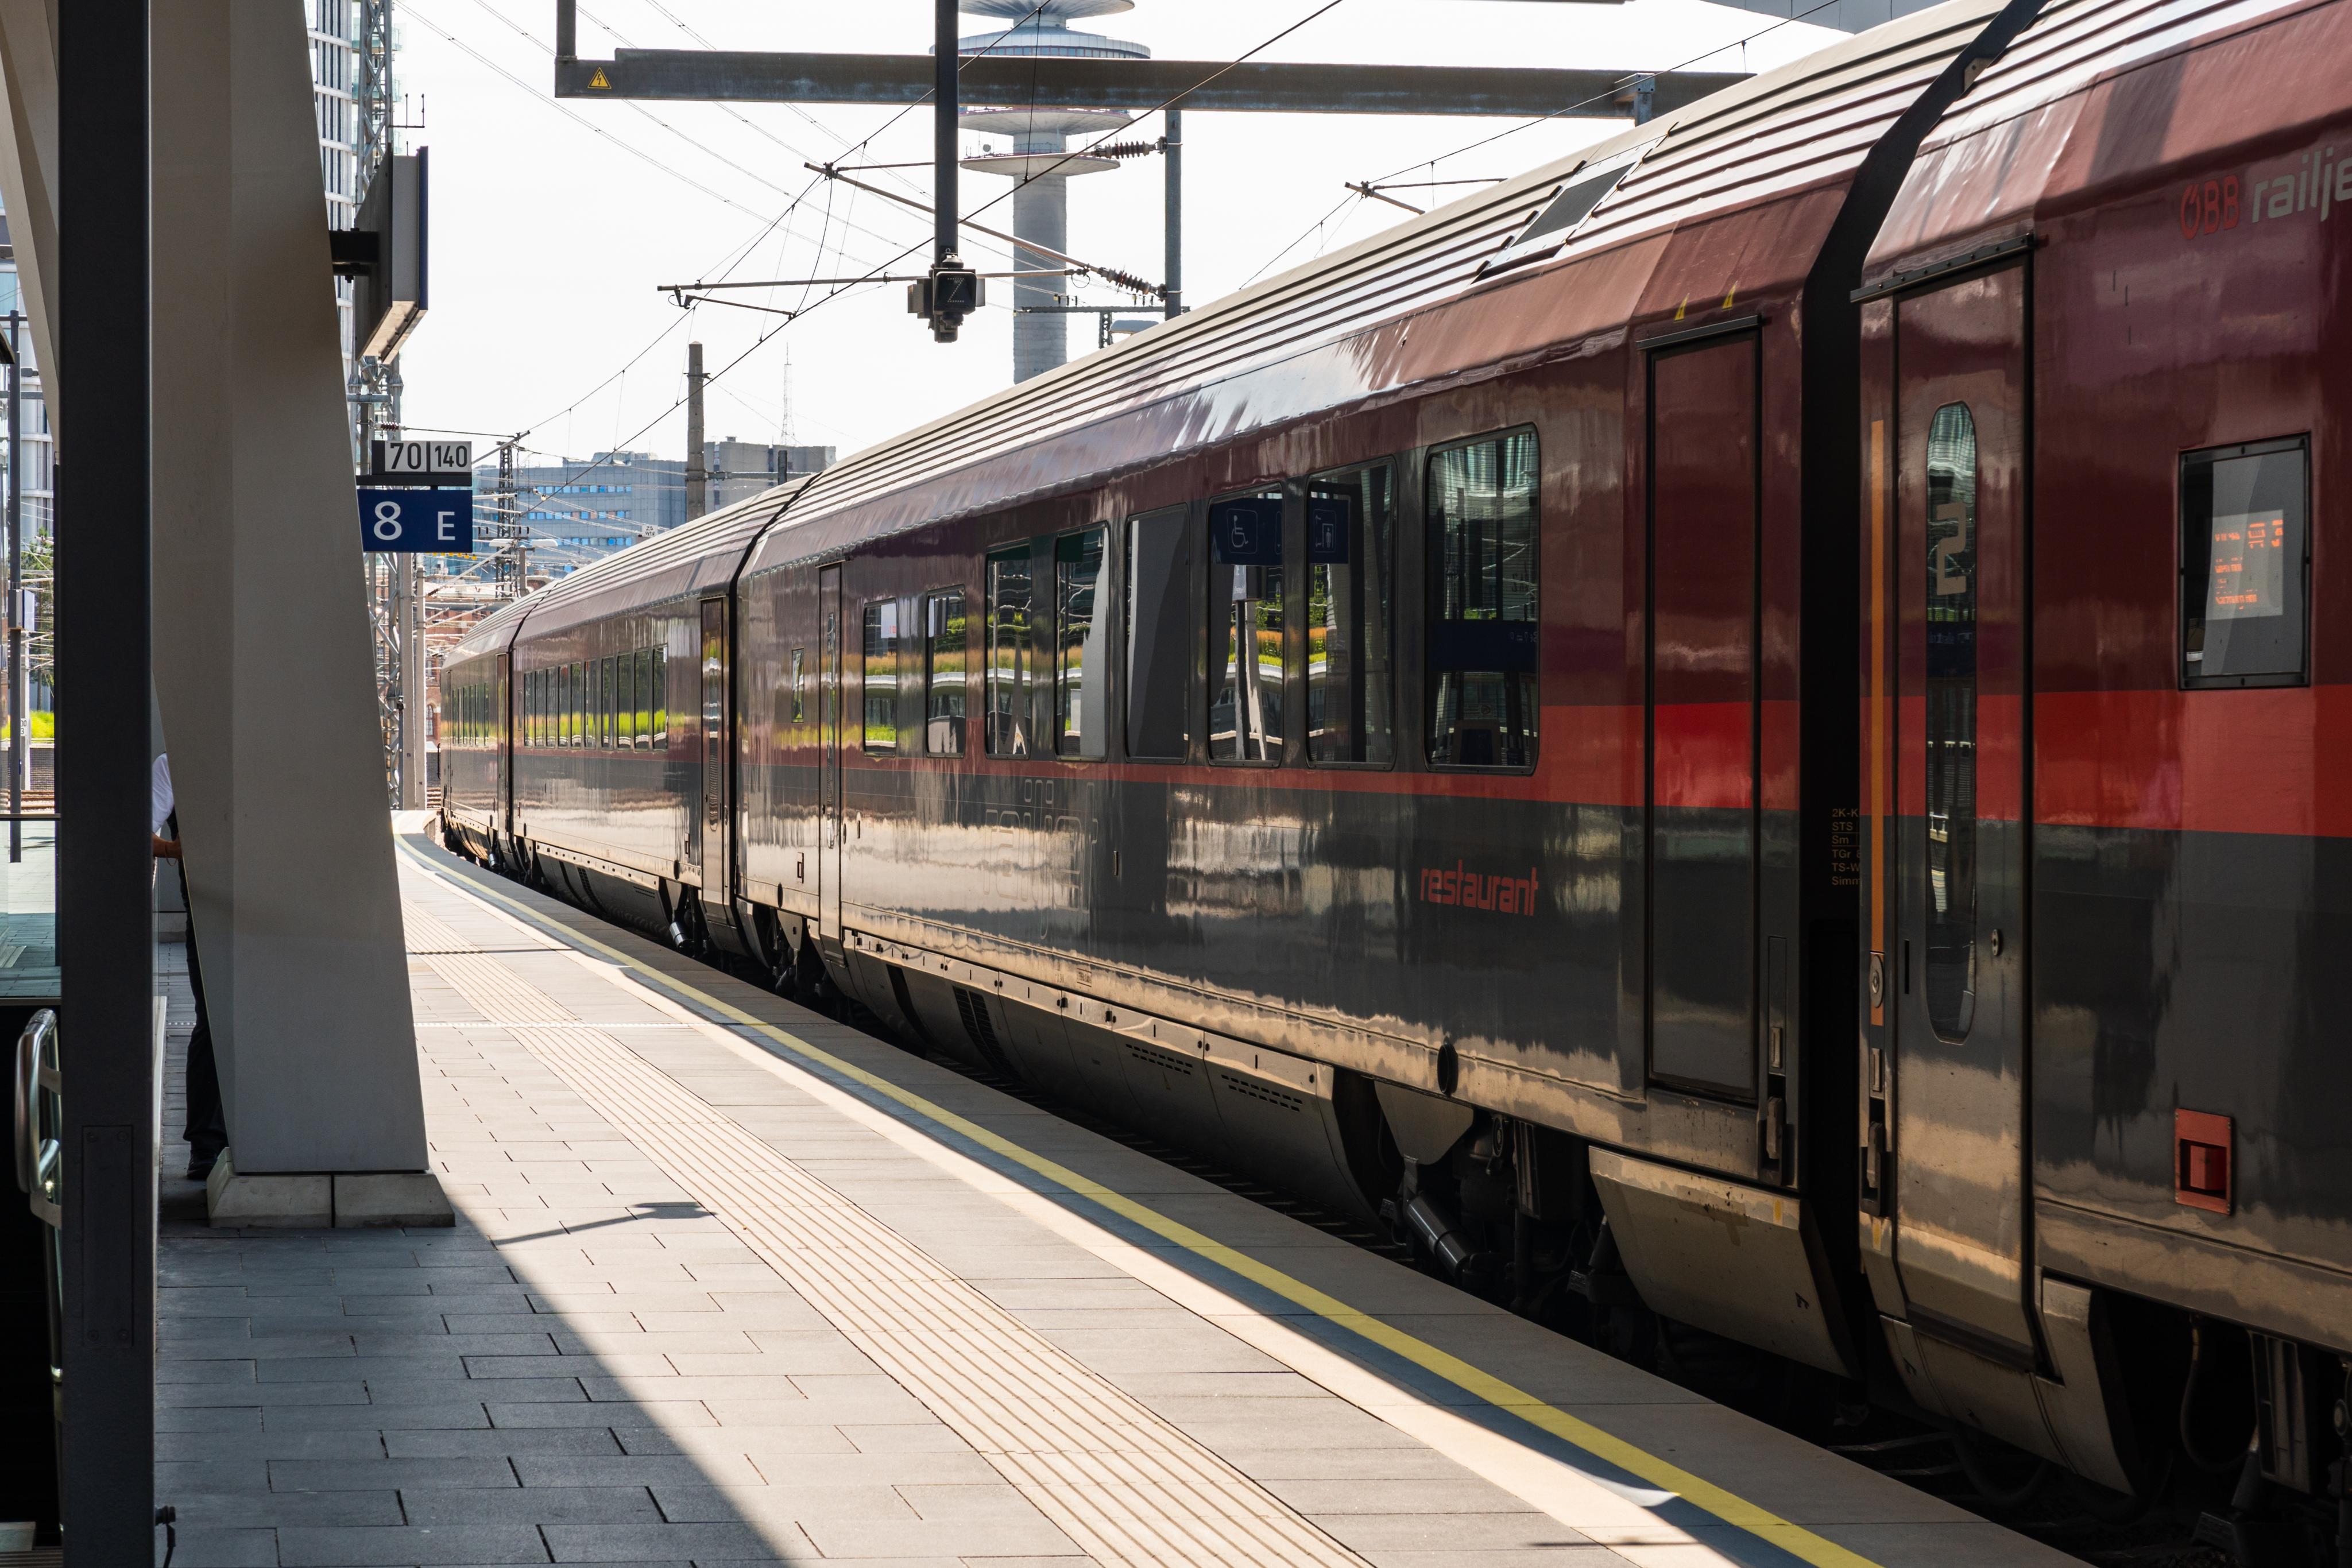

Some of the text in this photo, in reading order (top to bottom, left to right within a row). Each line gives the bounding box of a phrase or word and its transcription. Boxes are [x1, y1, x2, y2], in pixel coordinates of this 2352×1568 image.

[2180, 175, 2238, 240] ÖBB
[390, 442, 467, 470] 70 140
[373, 501, 455, 540] 8 E
[1936, 501, 1967, 596] 2
[1831, 808, 1859, 818] 2K-K
[1831, 822, 1854, 831] STS
[1831, 835, 1849, 844] Sm
[1831, 849, 1852, 858] TGr
[1419, 859, 1539, 916] restaurant
